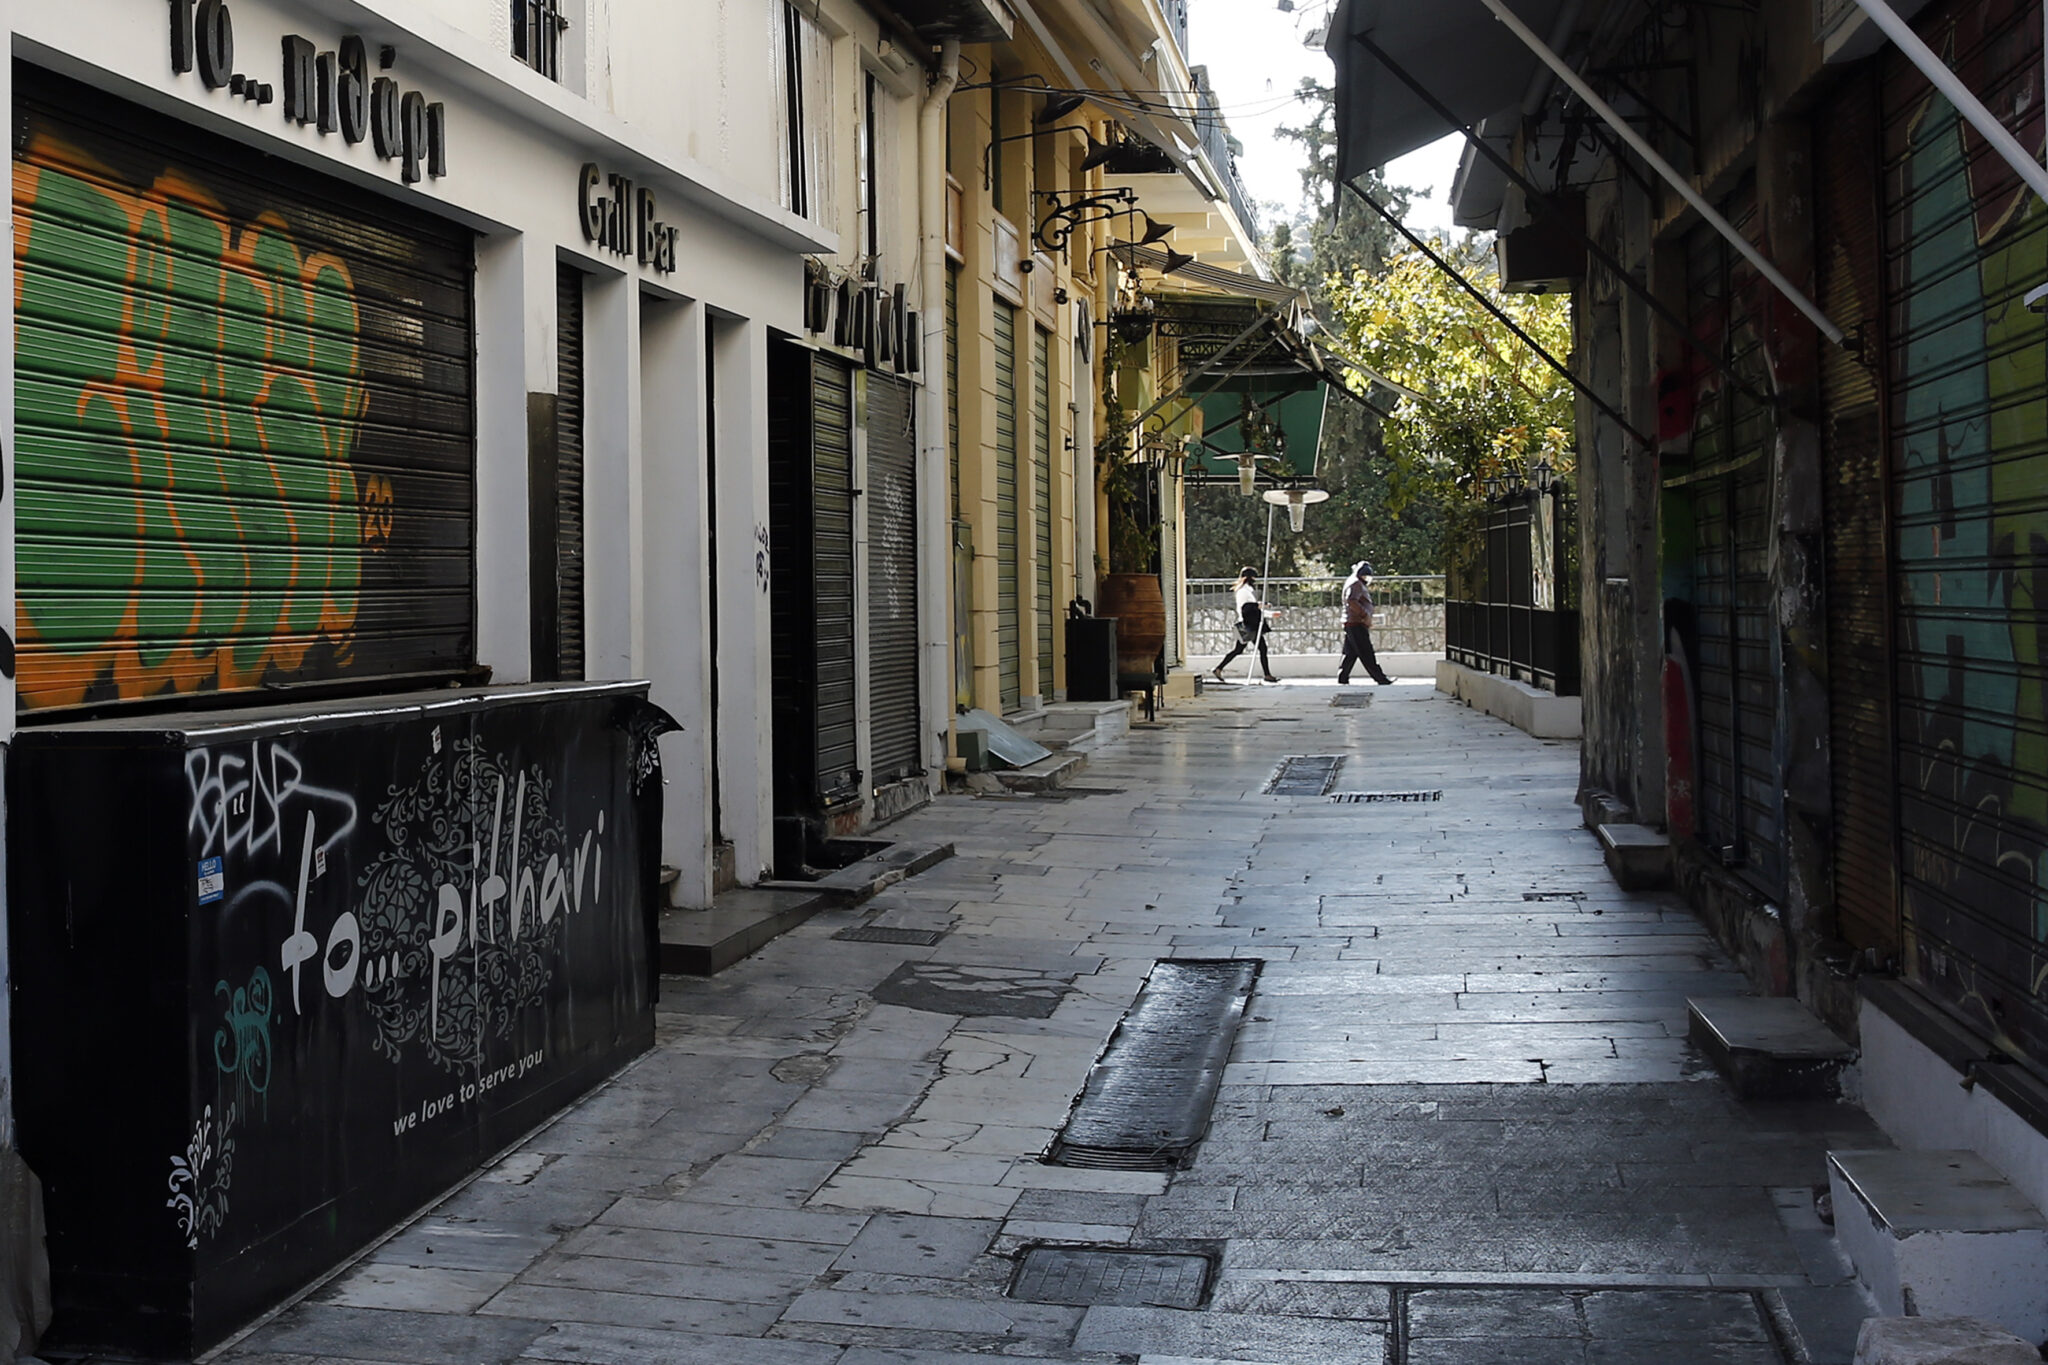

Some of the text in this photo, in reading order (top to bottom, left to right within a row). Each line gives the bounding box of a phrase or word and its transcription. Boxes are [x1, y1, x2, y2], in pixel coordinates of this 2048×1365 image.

[578, 162, 680, 274] Grill Bar
[428, 768, 605, 1042] pithari
[393, 1049, 544, 1136] we love to serve you
